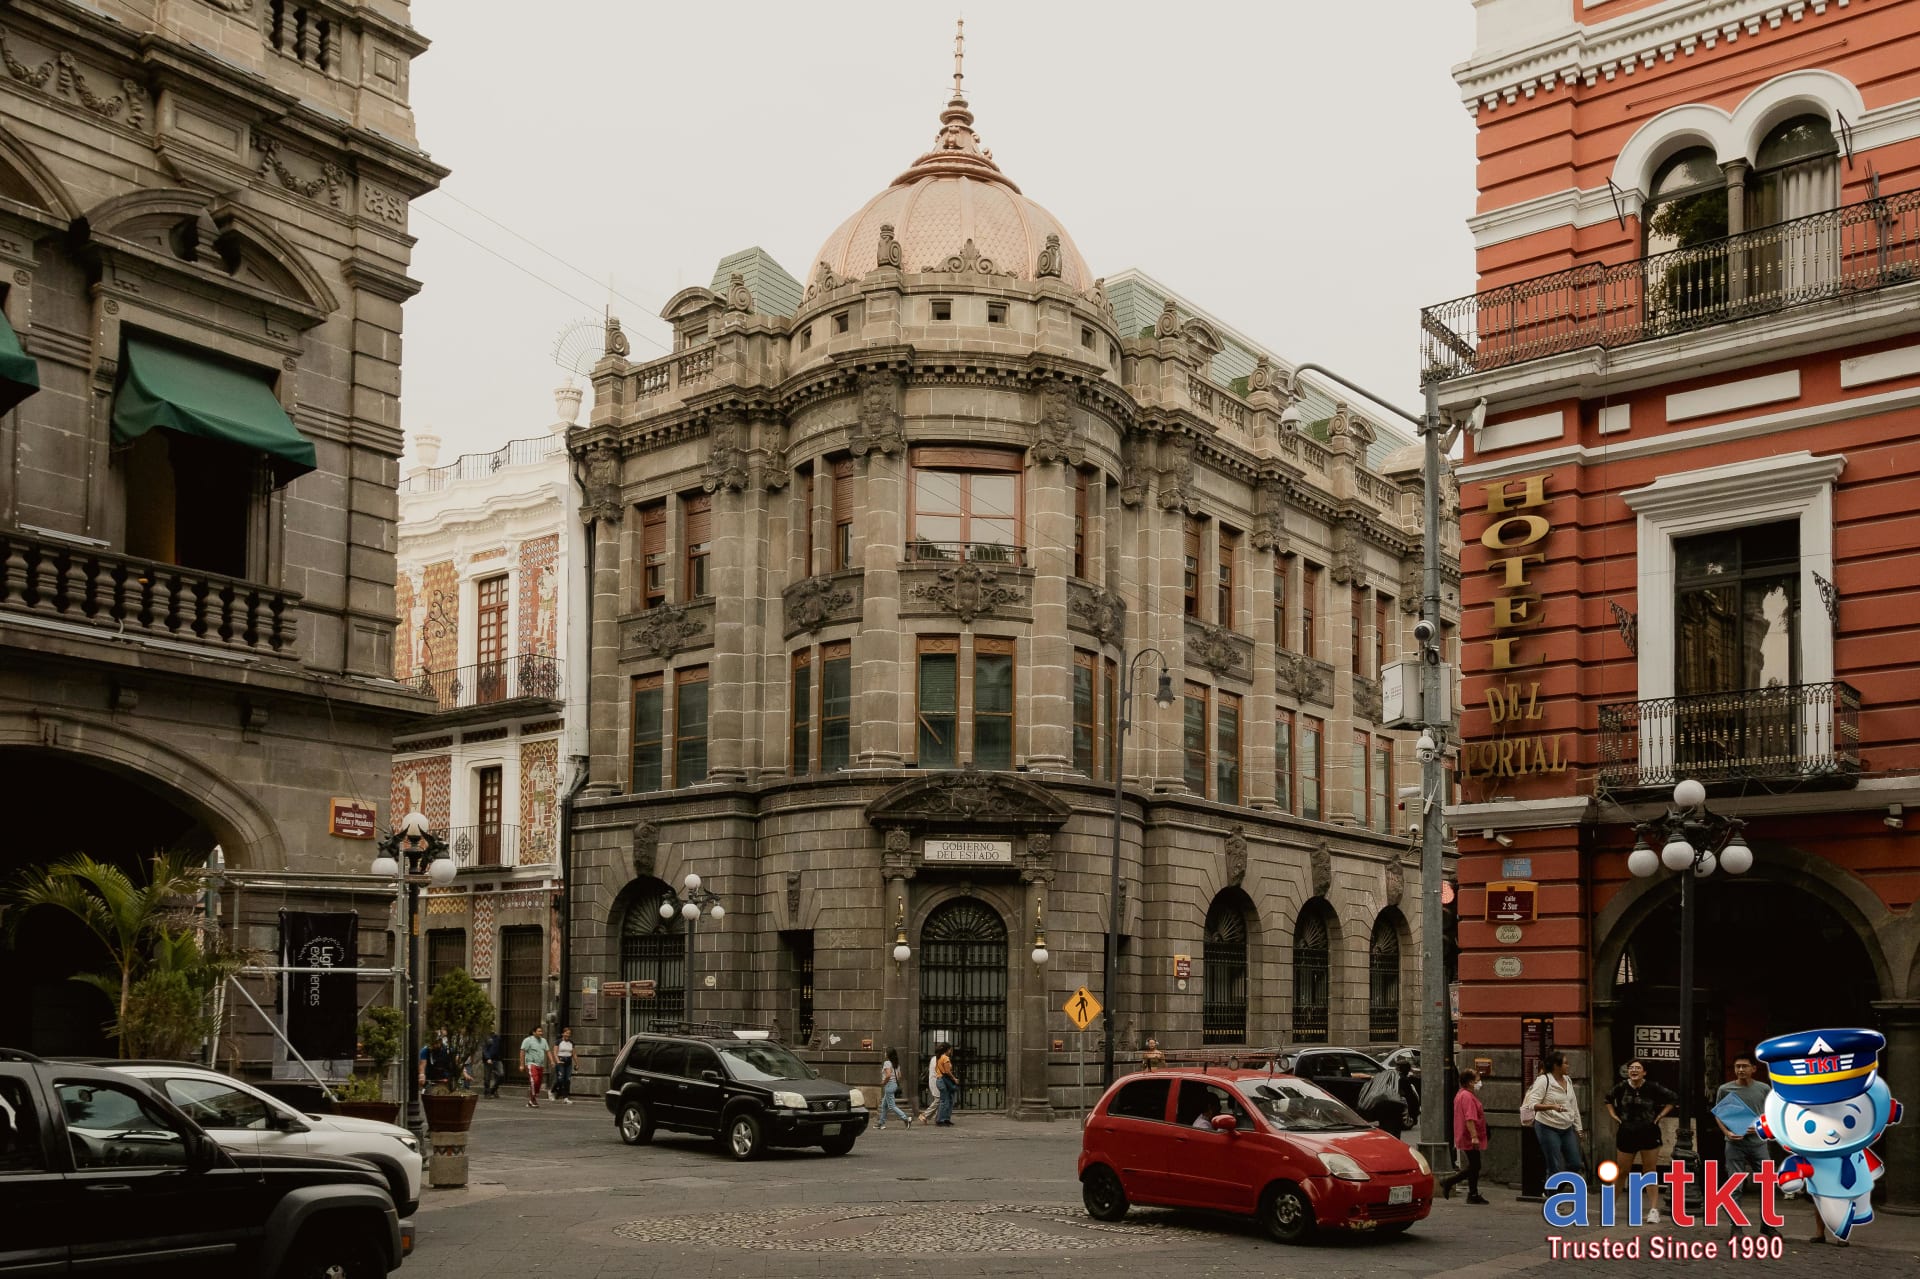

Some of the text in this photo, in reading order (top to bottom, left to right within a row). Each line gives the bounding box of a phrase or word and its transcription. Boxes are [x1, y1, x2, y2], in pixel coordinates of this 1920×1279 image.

[1479, 472, 1554, 670] HOTEL
[1484, 682, 1544, 724] DEL
[1462, 734, 1568, 781] PORTAL
[937, 850, 1000, 861] DEL ESTADO
[942, 842, 994, 852] GOBIERNO
[1502, 902, 1518, 911] 2 Sur
[320, 946, 335, 975] Ligh
[307, 946, 321, 1007] expeiences
[1637, 1048, 1680, 1058] DE PUEBL
